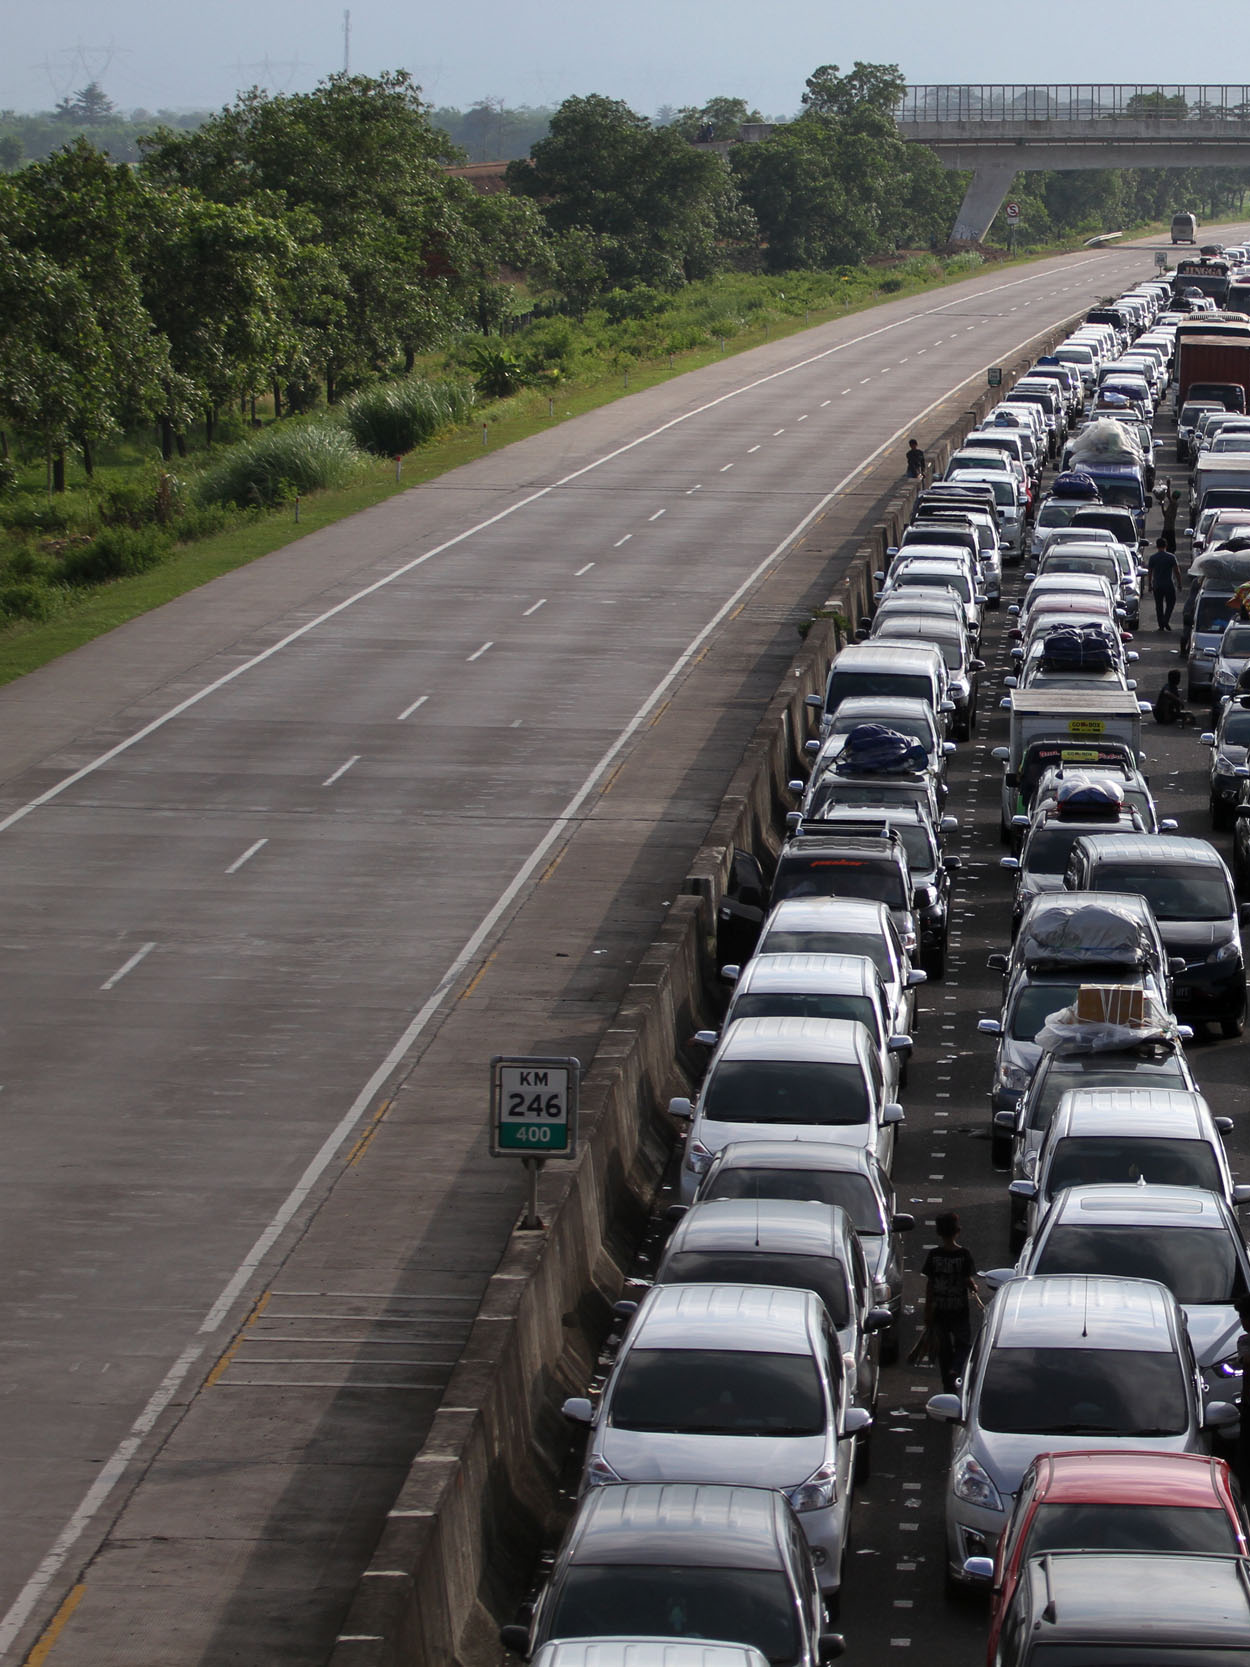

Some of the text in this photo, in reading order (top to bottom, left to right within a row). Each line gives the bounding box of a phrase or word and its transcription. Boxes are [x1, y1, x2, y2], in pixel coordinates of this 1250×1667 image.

[1183, 266, 1223, 276] JINGGA
[520, 1071, 549, 1087] KM
[508, 1093, 562, 1118] 246
[516, 1126, 551, 1142] 400
